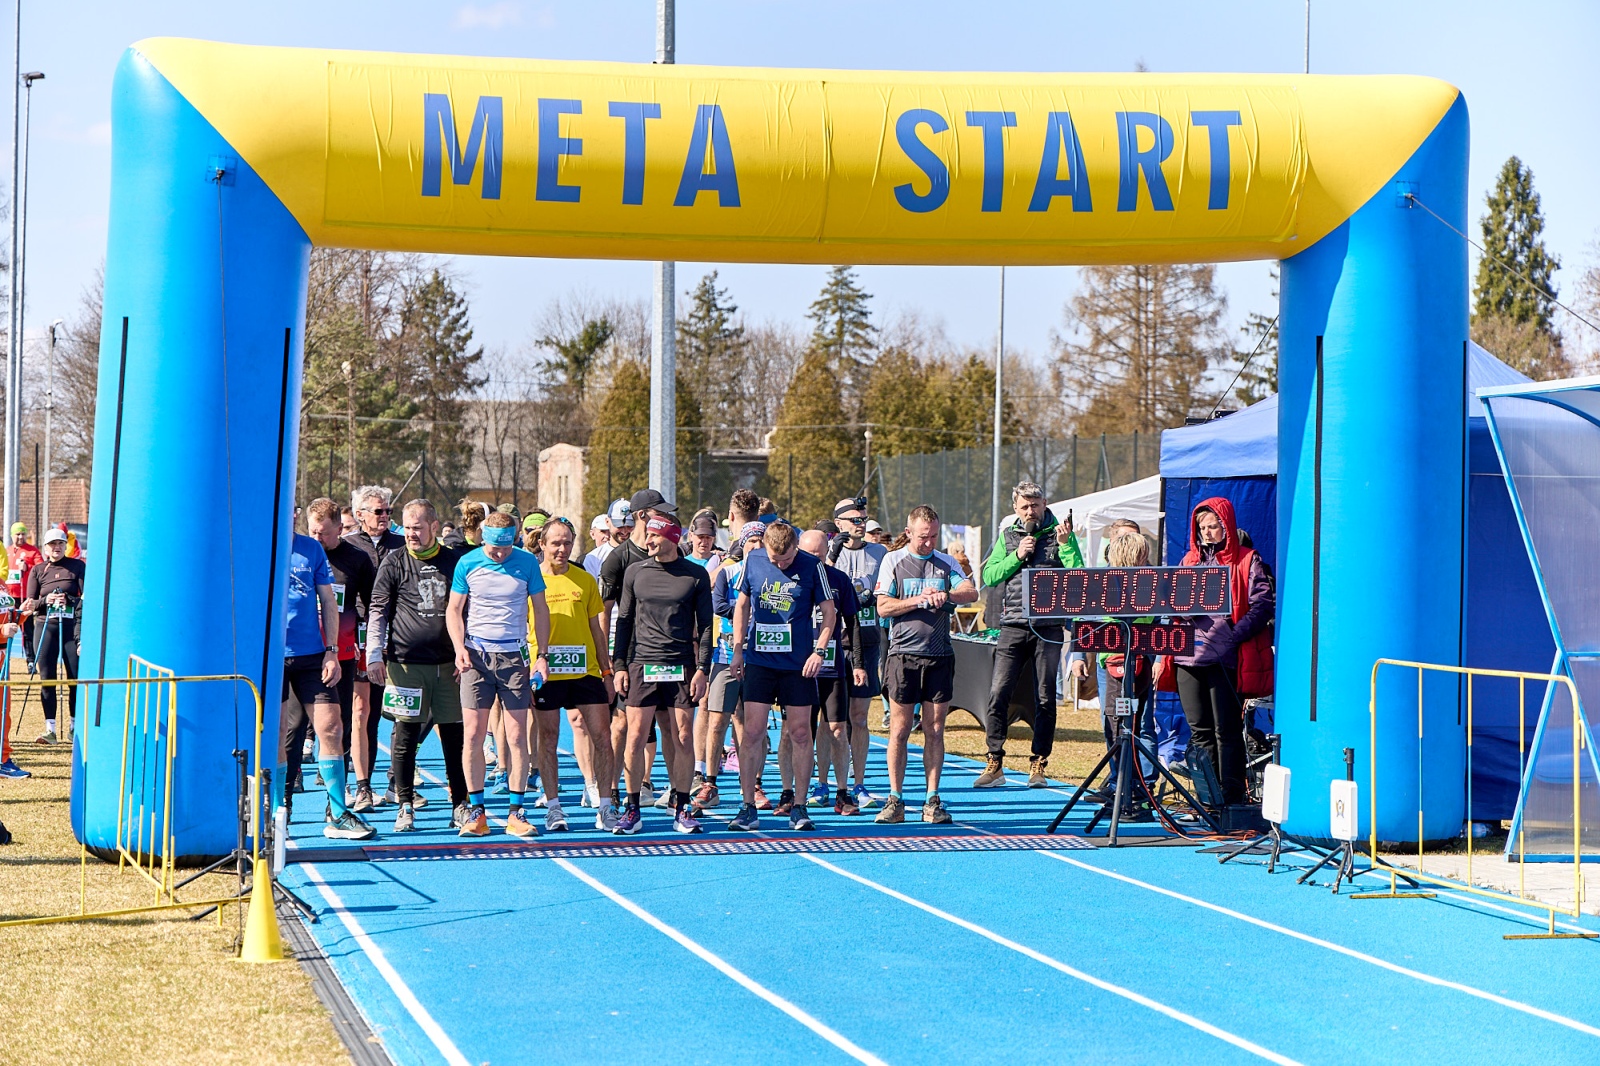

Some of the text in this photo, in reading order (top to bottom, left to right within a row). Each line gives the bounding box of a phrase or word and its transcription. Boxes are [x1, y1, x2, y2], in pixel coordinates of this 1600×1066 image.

[421, 93, 1243, 213] META START
[1031, 569, 1226, 612] 00:00:00
[760, 632, 784, 643] 229
[553, 653, 580, 664] 230
[388, 694, 415, 707] 238
